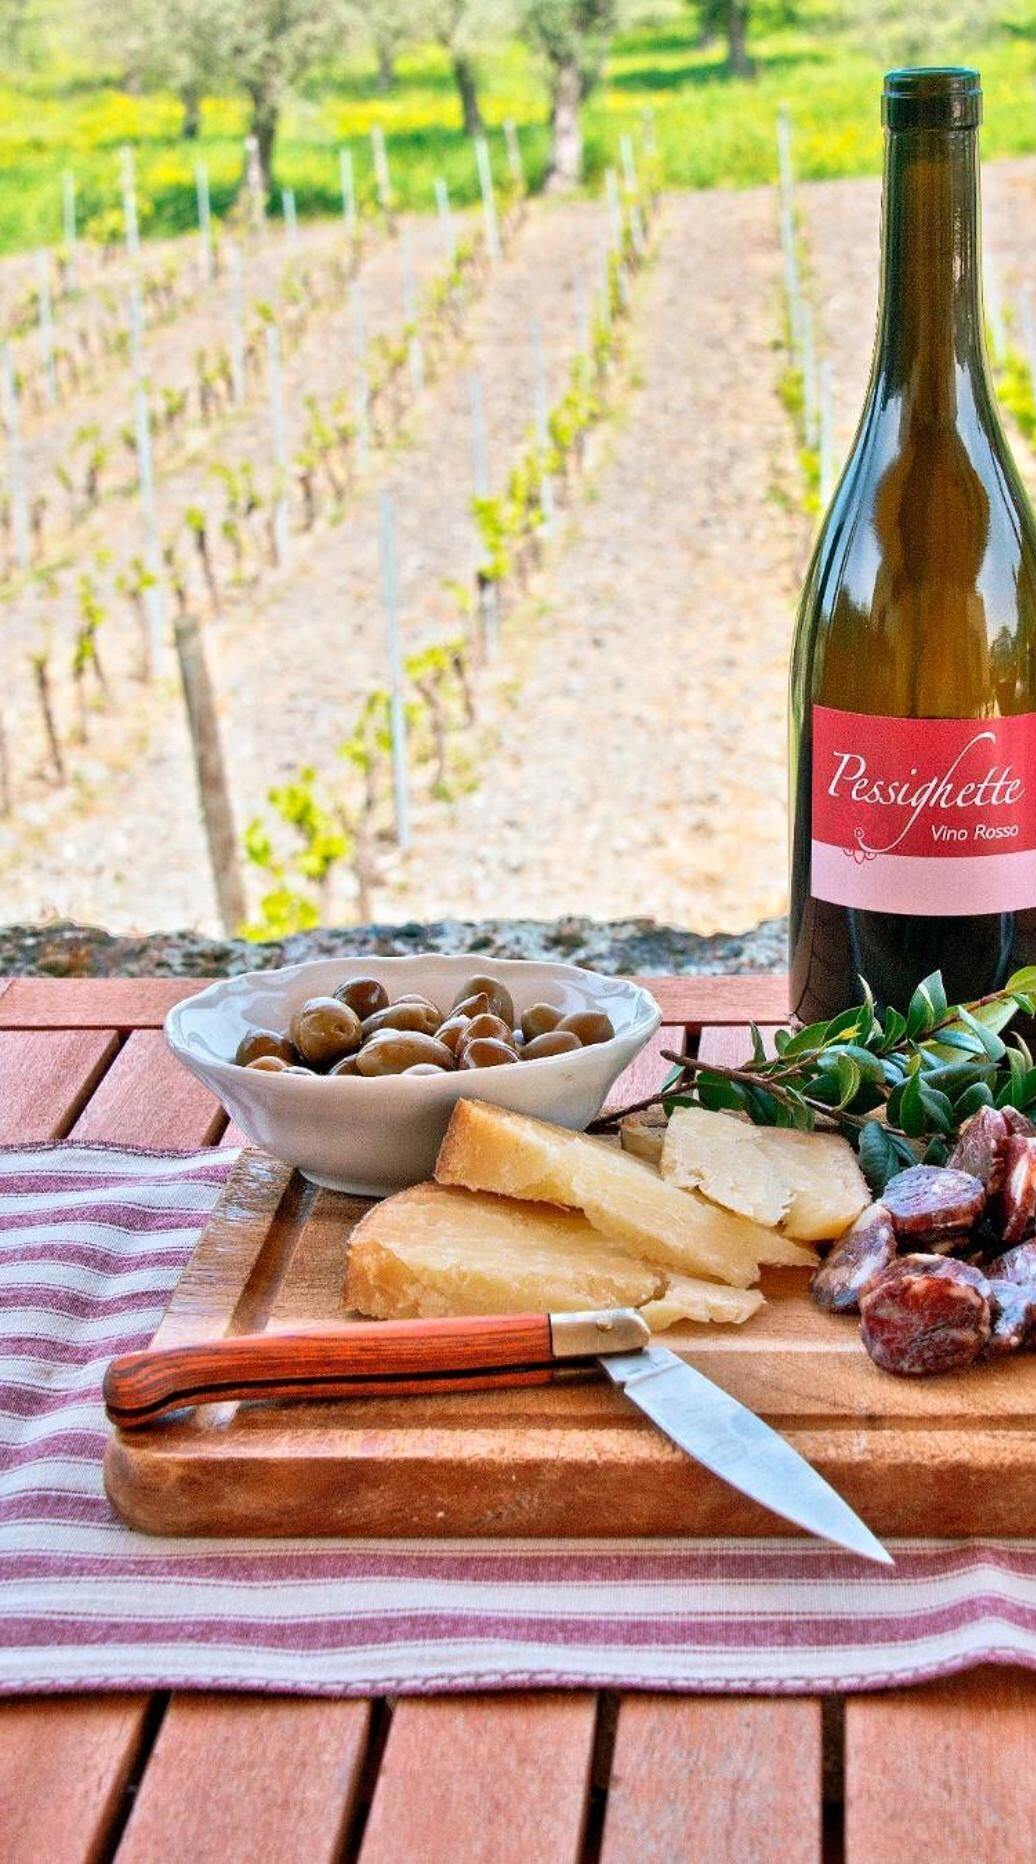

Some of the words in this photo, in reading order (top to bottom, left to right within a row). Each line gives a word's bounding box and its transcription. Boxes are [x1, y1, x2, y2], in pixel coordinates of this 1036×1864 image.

[827, 731, 1025, 853] Pessighette
[931, 825, 967, 841] Vino
[974, 823, 1019, 841] Rosso
